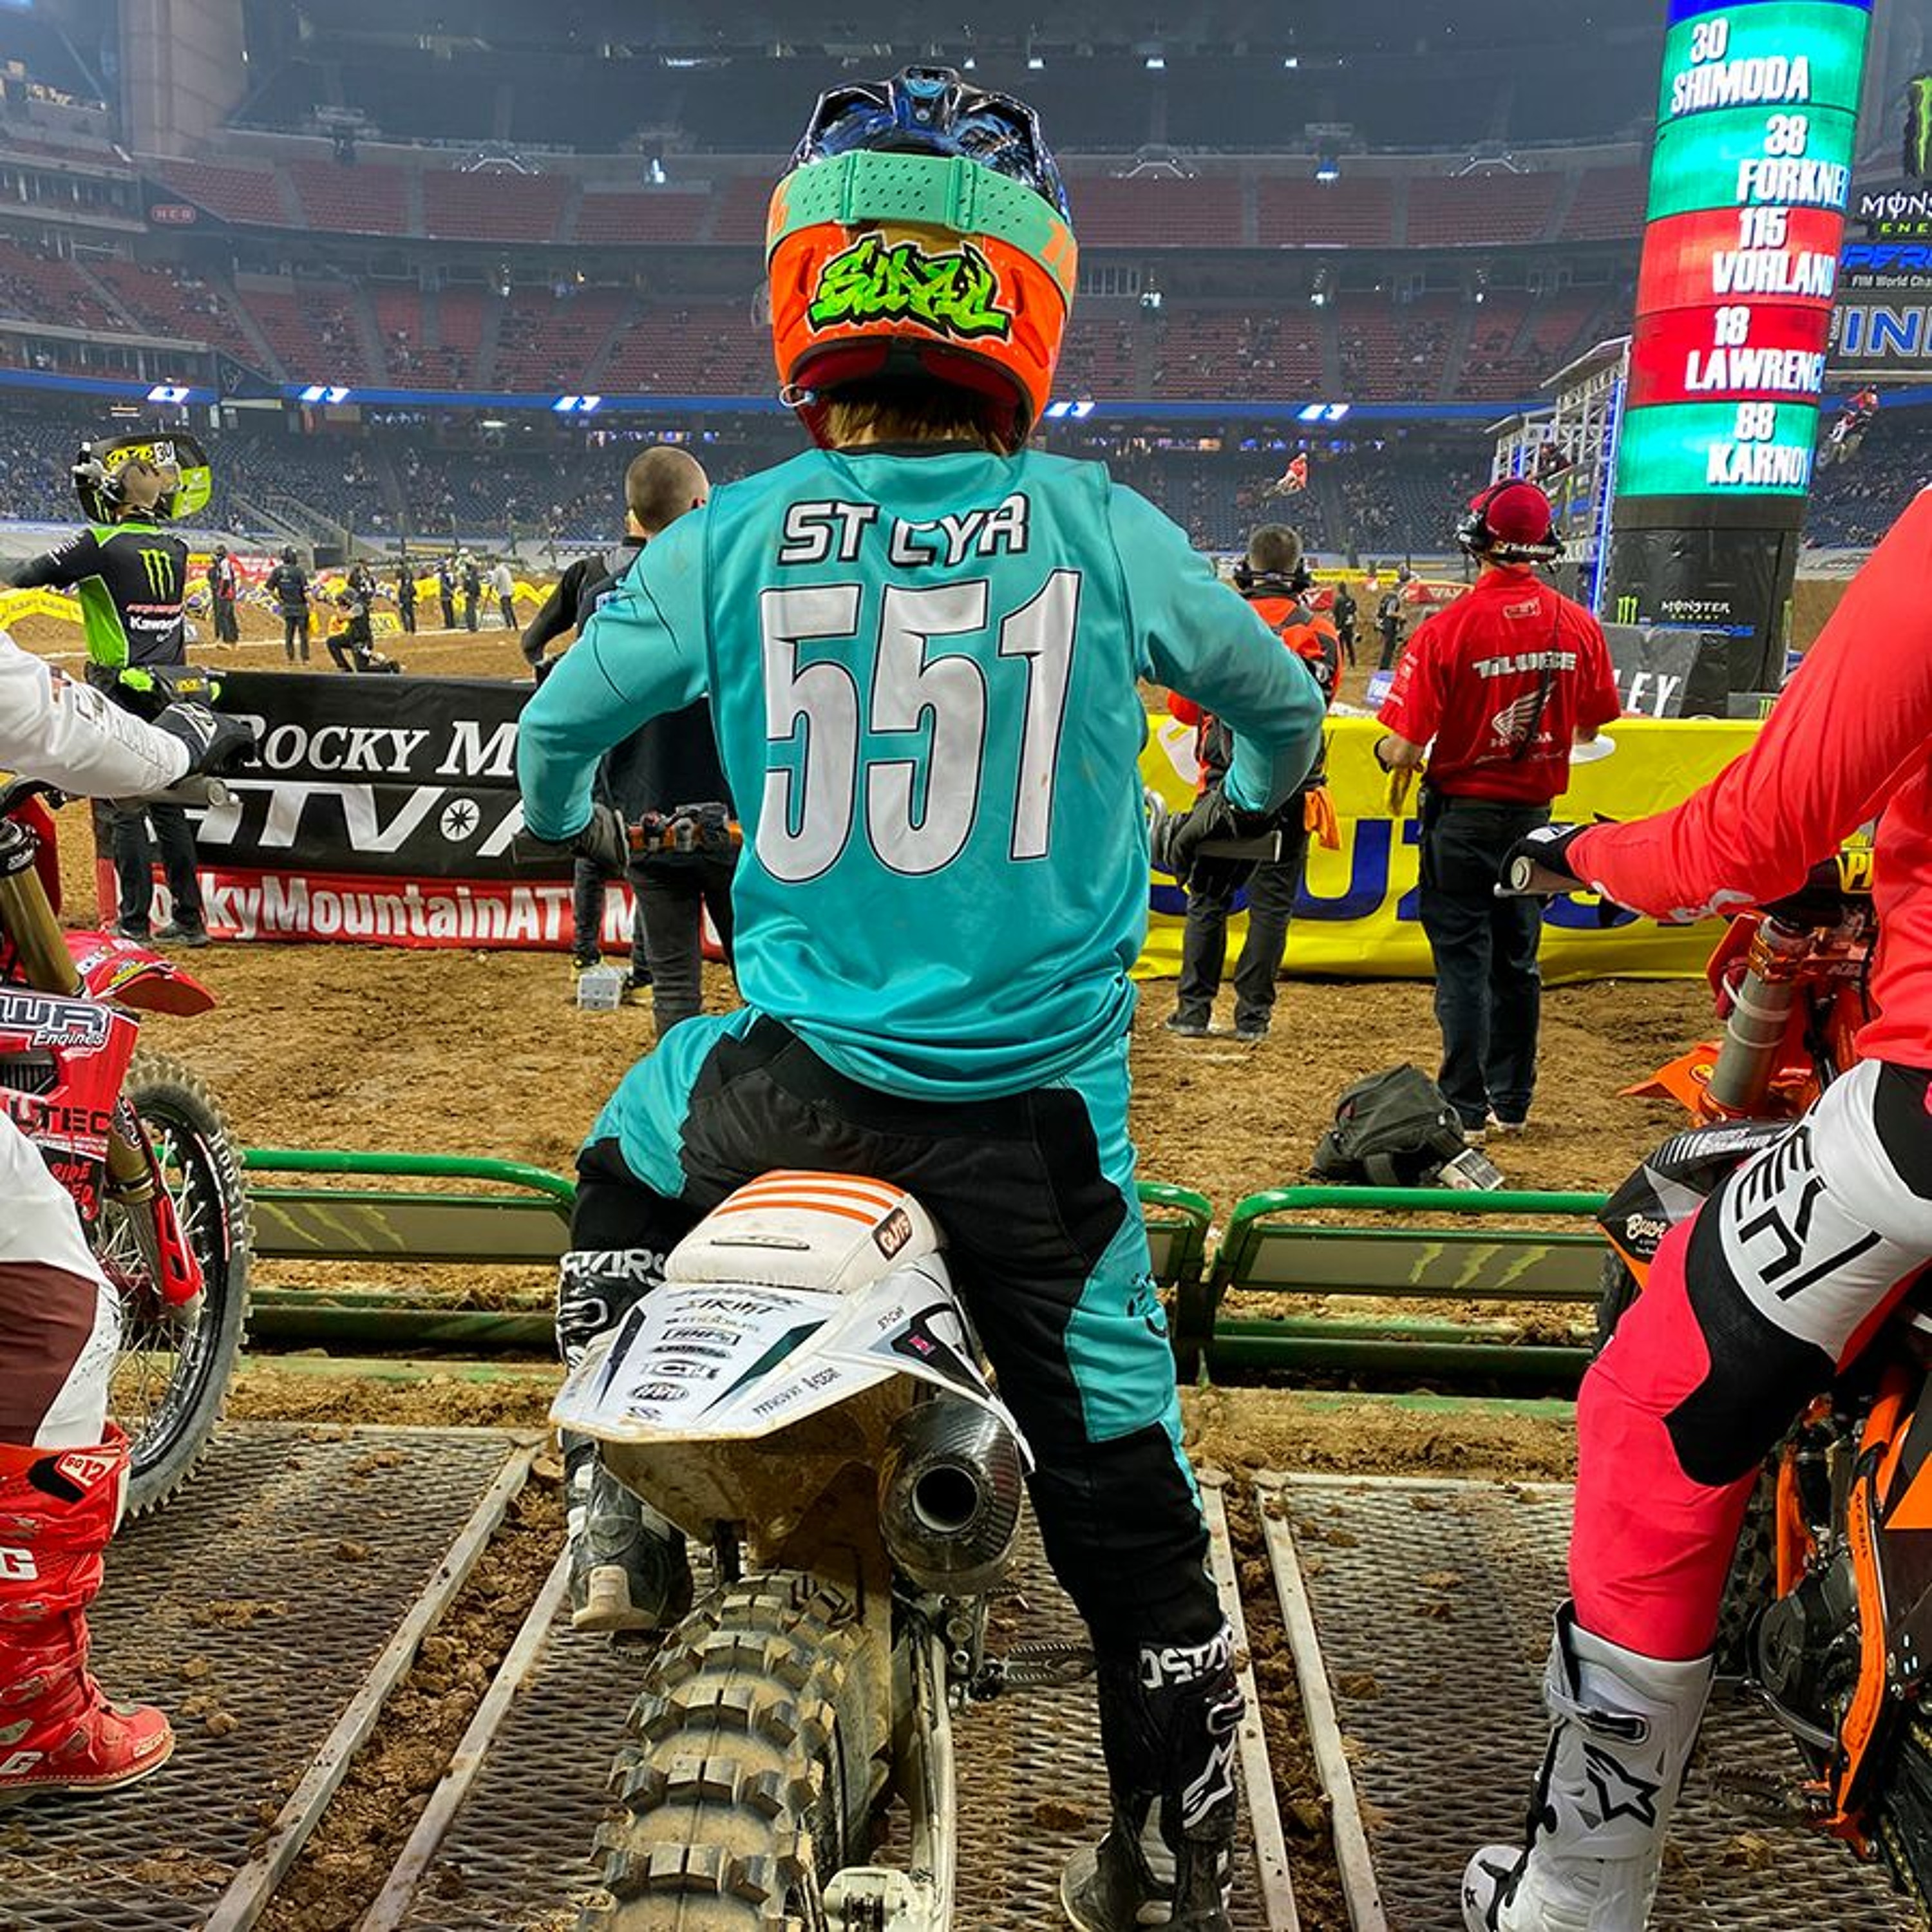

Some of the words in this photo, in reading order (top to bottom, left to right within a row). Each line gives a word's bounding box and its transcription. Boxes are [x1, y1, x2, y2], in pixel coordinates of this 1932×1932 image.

[1690, 17, 1728, 63] 30
[1671, 55, 1808, 114] SHIMODA
[1763, 113, 1808, 156] 38
[1738, 206, 1788, 249] 115
[1713, 306, 1751, 346] 18
[1734, 402, 1777, 442] 88
[777, 500, 880, 567] ST
[888, 492, 1031, 567] CYR
[755, 568, 1083, 885] 551
[33, 1028, 104, 1047] Engines
[71, 1184, 94, 1207] ED
